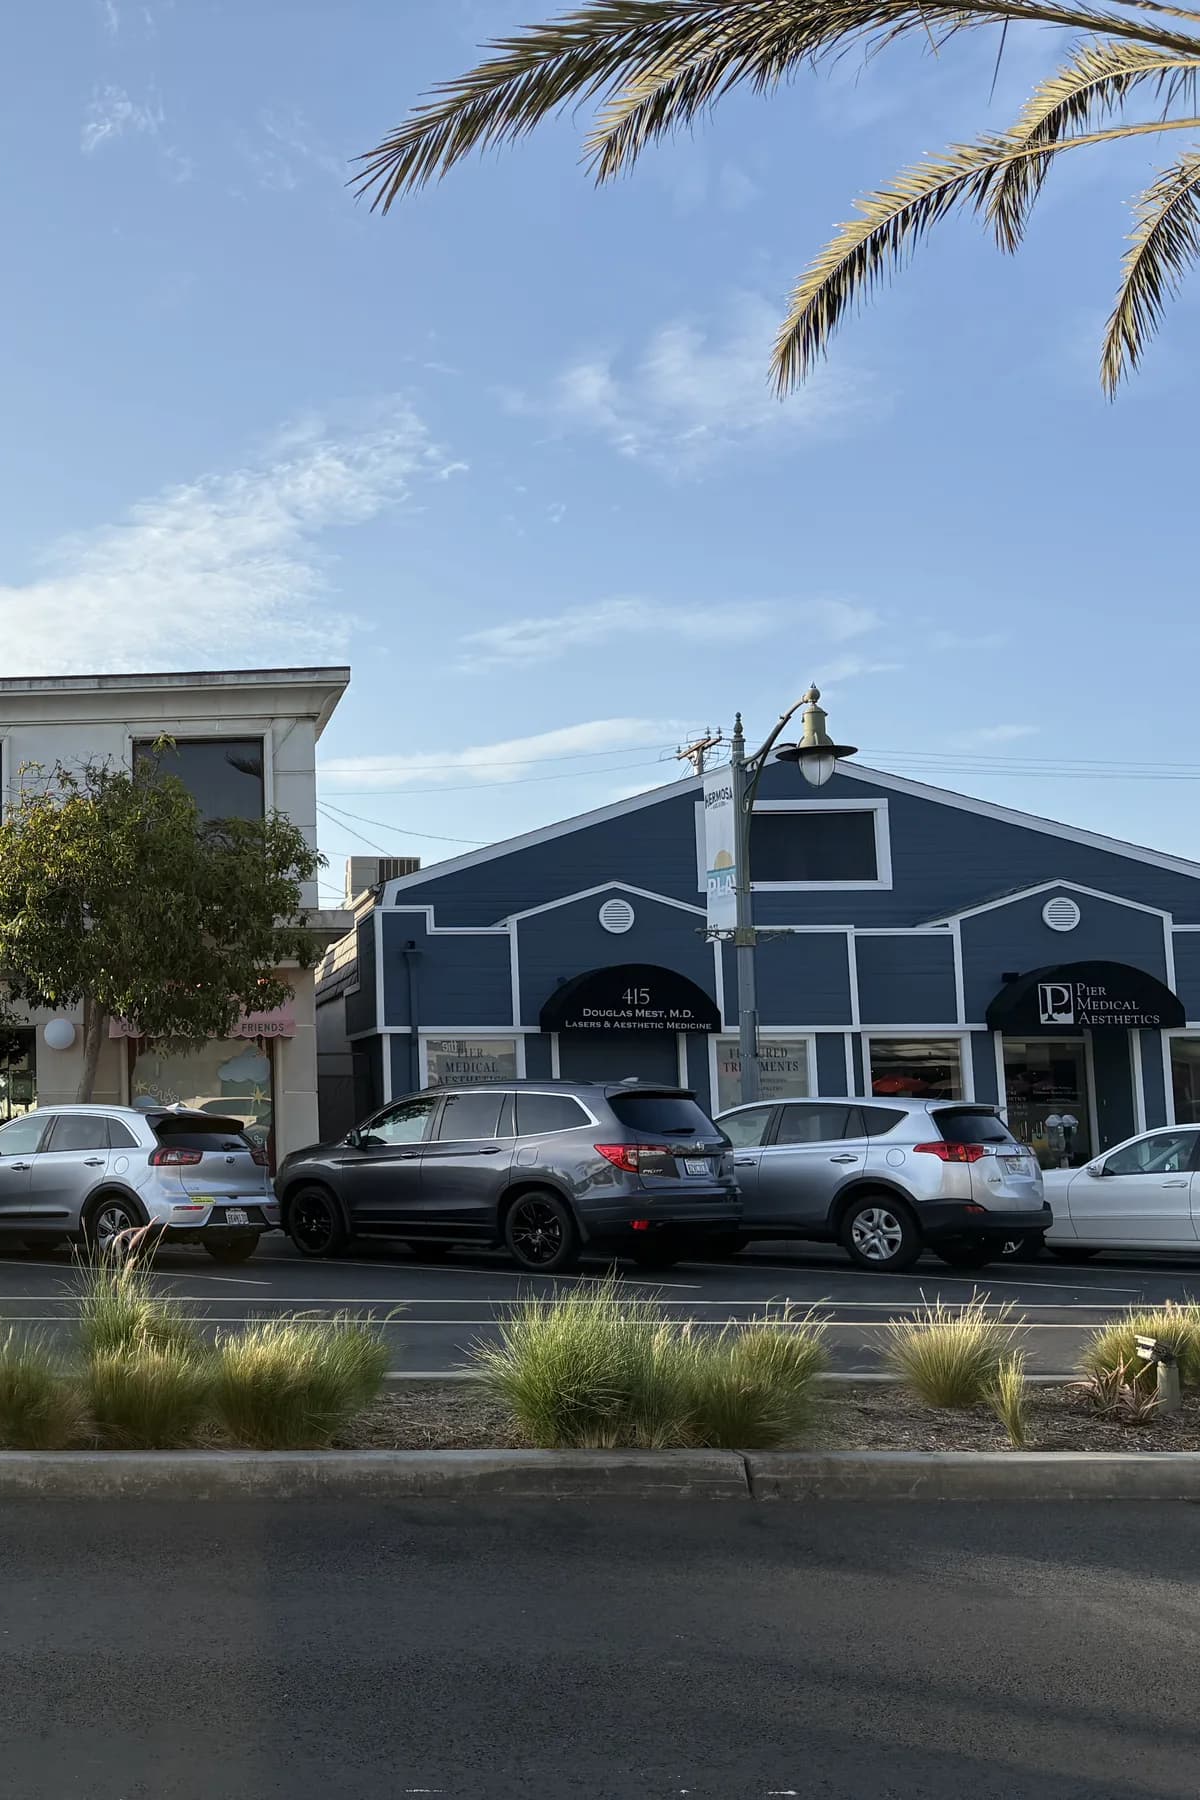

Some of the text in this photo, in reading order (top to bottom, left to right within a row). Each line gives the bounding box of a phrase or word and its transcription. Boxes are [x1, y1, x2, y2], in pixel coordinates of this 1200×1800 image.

[1076, 982, 1107, 996] PIER
[621, 988, 650, 1005] 415
[1076, 997, 1140, 1011] MEDICAL
[582, 1008, 695, 1019] DOUGLAS MEST, M.D.
[1077, 1011, 1161, 1025] AESTHETICS
[241, 1023, 285, 1032] FRIENDS
[565, 1020, 712, 1030] LASERS & AESTHETIC MEDICINE
[445, 1061, 499, 1073] MEDICAL
